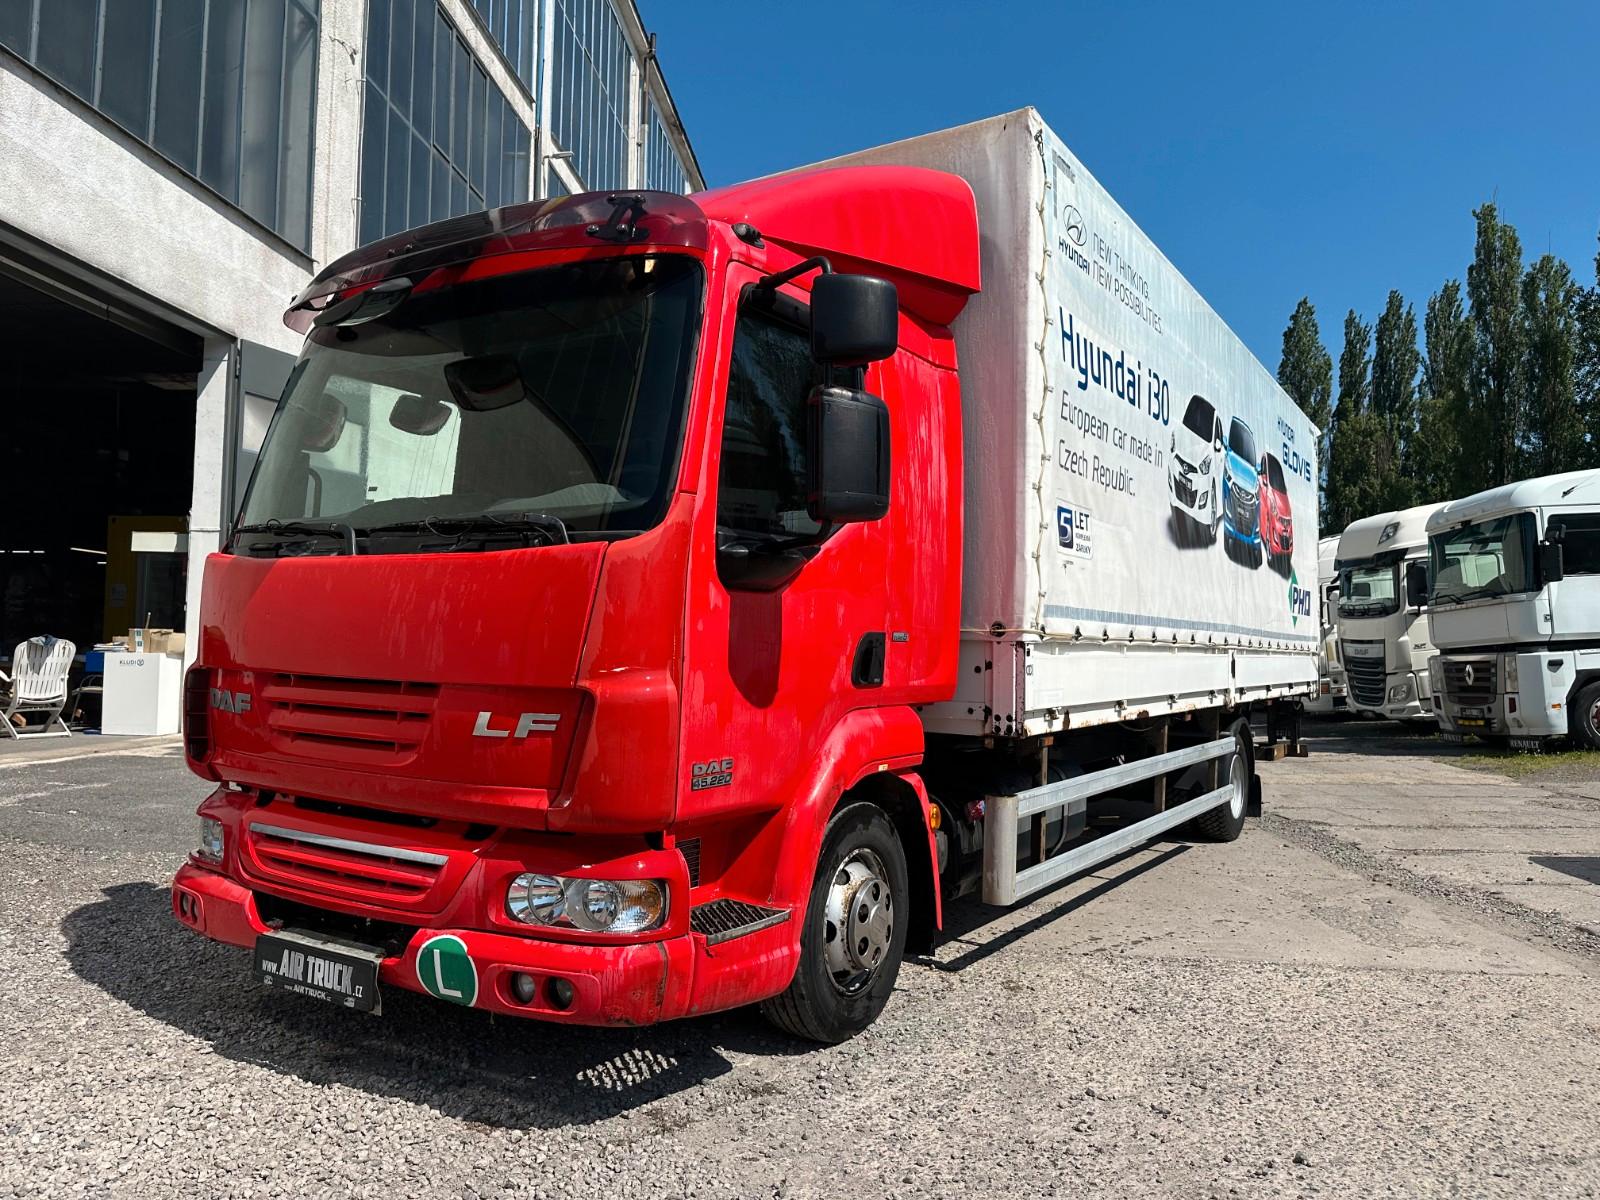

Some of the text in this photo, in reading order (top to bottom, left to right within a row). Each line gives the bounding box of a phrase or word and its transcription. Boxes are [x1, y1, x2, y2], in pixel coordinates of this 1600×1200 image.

[1058, 236, 1091, 275] HYUNDAI
[1093, 232, 1150, 301] NEW THINKING.
[1092, 259, 1164, 335] NEW POSSIBILITIES.
[1059, 305, 1170, 426] Hyundai i30
[1061, 389, 1163, 469] European car made in
[1058, 438, 1136, 497] Czech Republic.
[1282, 441, 1311, 483] GLOVIS
[1059, 509, 1090, 543] 5 LET
[209, 687, 251, 714] DAF
[472, 711, 561, 738] LF
[692, 759, 733, 776] DAF
[692, 773, 732, 788] 45.220
[433, 948, 463, 998] L
